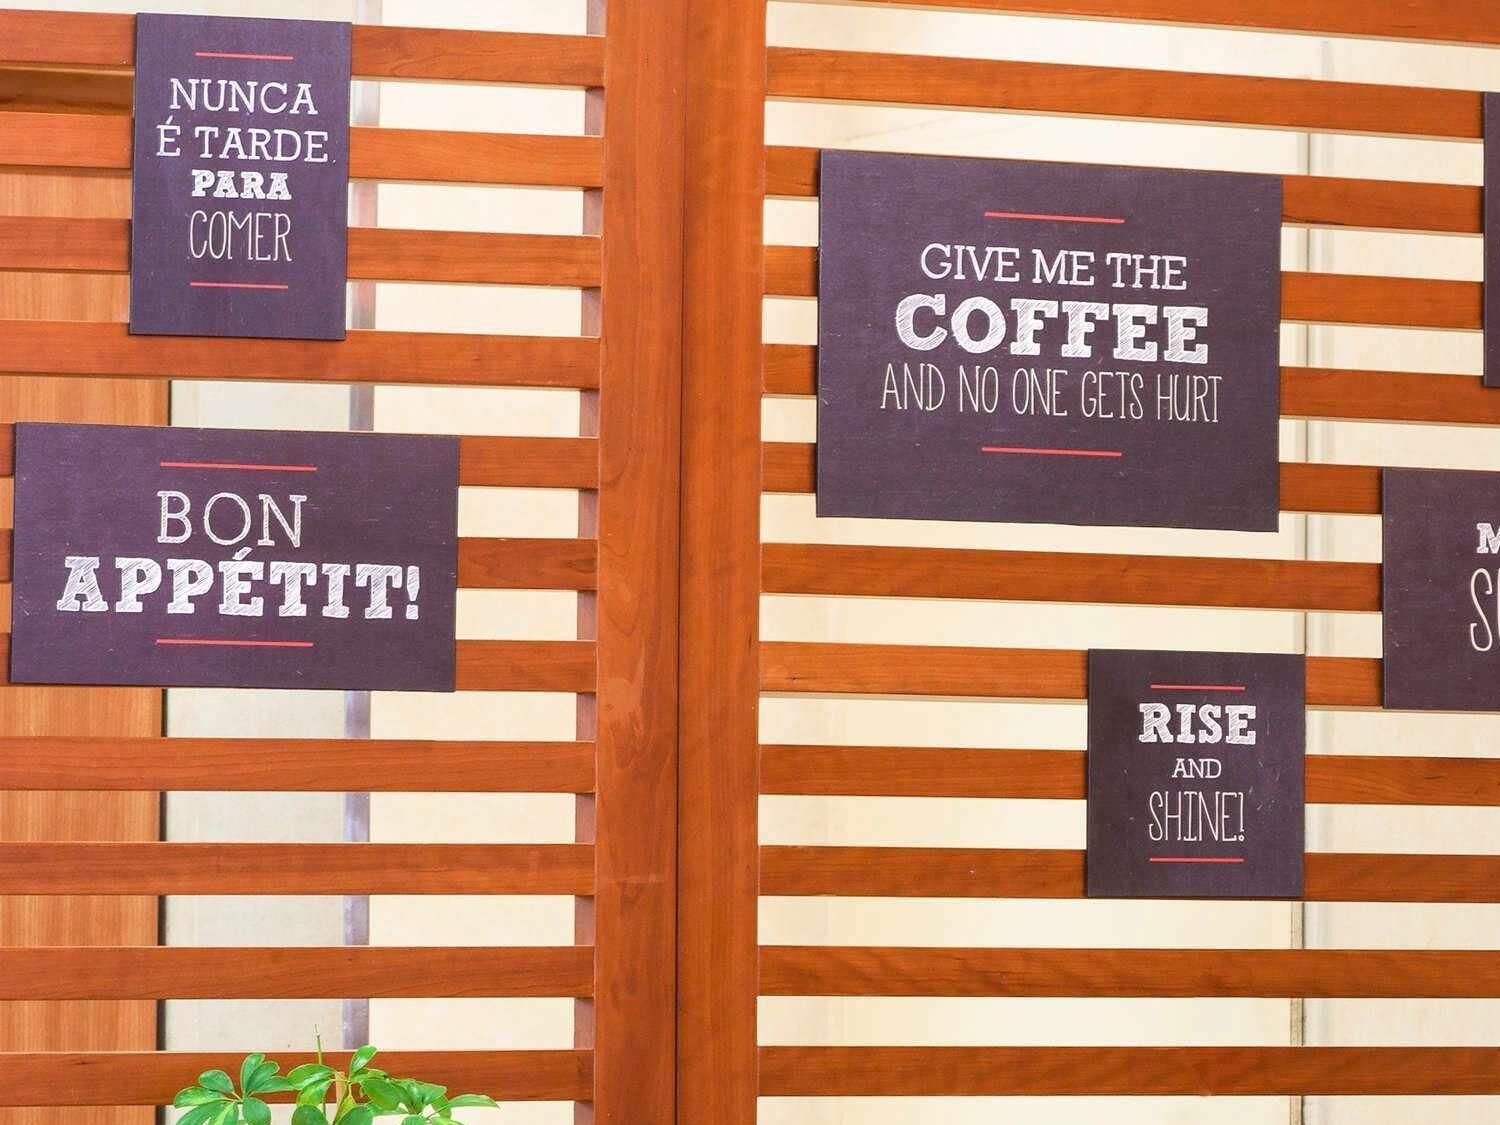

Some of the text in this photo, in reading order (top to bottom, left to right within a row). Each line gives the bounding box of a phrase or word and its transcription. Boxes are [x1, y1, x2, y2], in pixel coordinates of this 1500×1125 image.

[170, 78, 318, 114] NUNCA
[157, 116, 328, 162] É TARDE
[192, 170, 291, 200] PARA
[190, 210, 292, 261] COMER
[921, 243, 1186, 290] GIVE ME THE
[895, 294, 1208, 364] COFFEE
[881, 363, 1222, 422] AND NO ONE GETS HURT
[157, 491, 307, 548] BON
[56, 547, 419, 619] APPÉTIT!
[1139, 703, 1256, 745] RISE
[1172, 758, 1221, 778] AND
[1149, 791, 1244, 841] SHINE!
